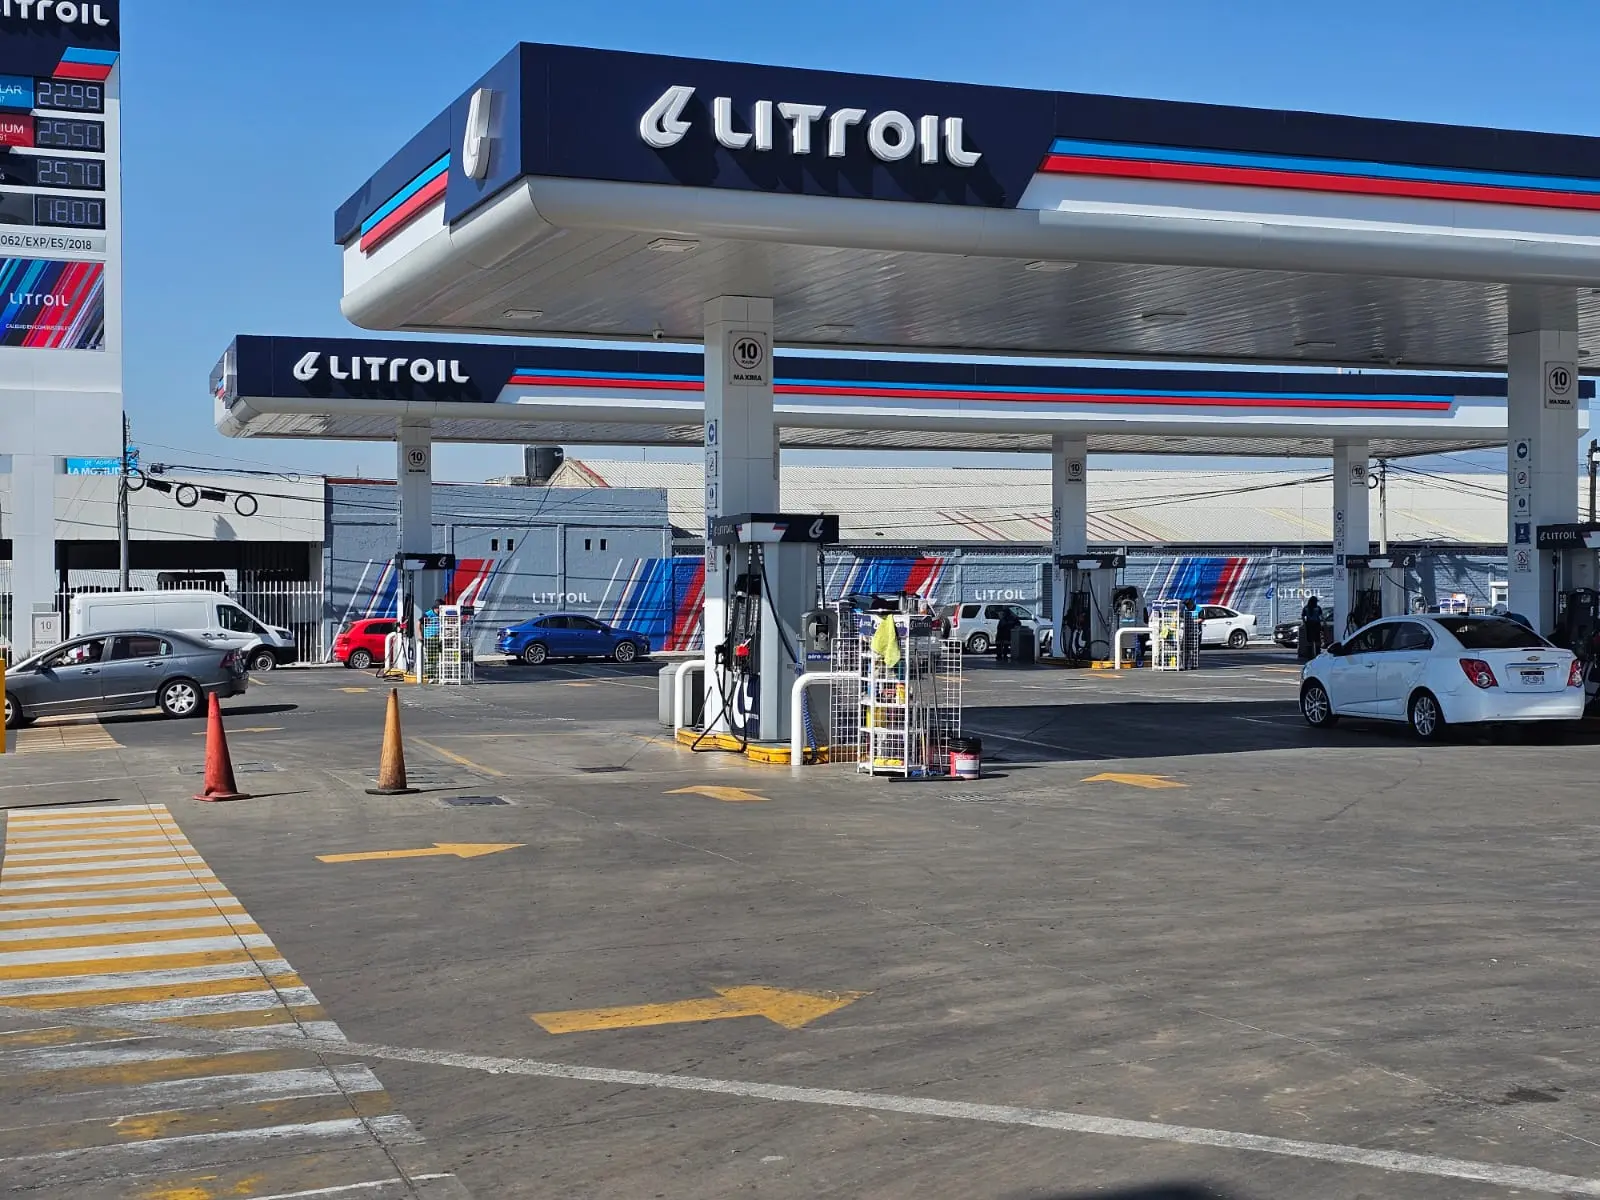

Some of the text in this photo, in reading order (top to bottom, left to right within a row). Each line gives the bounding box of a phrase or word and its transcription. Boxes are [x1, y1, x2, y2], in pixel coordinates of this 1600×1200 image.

[0, 0, 110, 26] ITROIL
[38, 82, 100, 109] 22.99
[0, 123, 24, 134] IUM
[713, 96, 982, 168] LITROIL
[38, 160, 101, 186] 25.70
[738, 342, 758, 360] 10
[330, 355, 470, 383] LITROIL
[1553, 371, 1567, 386] 10
